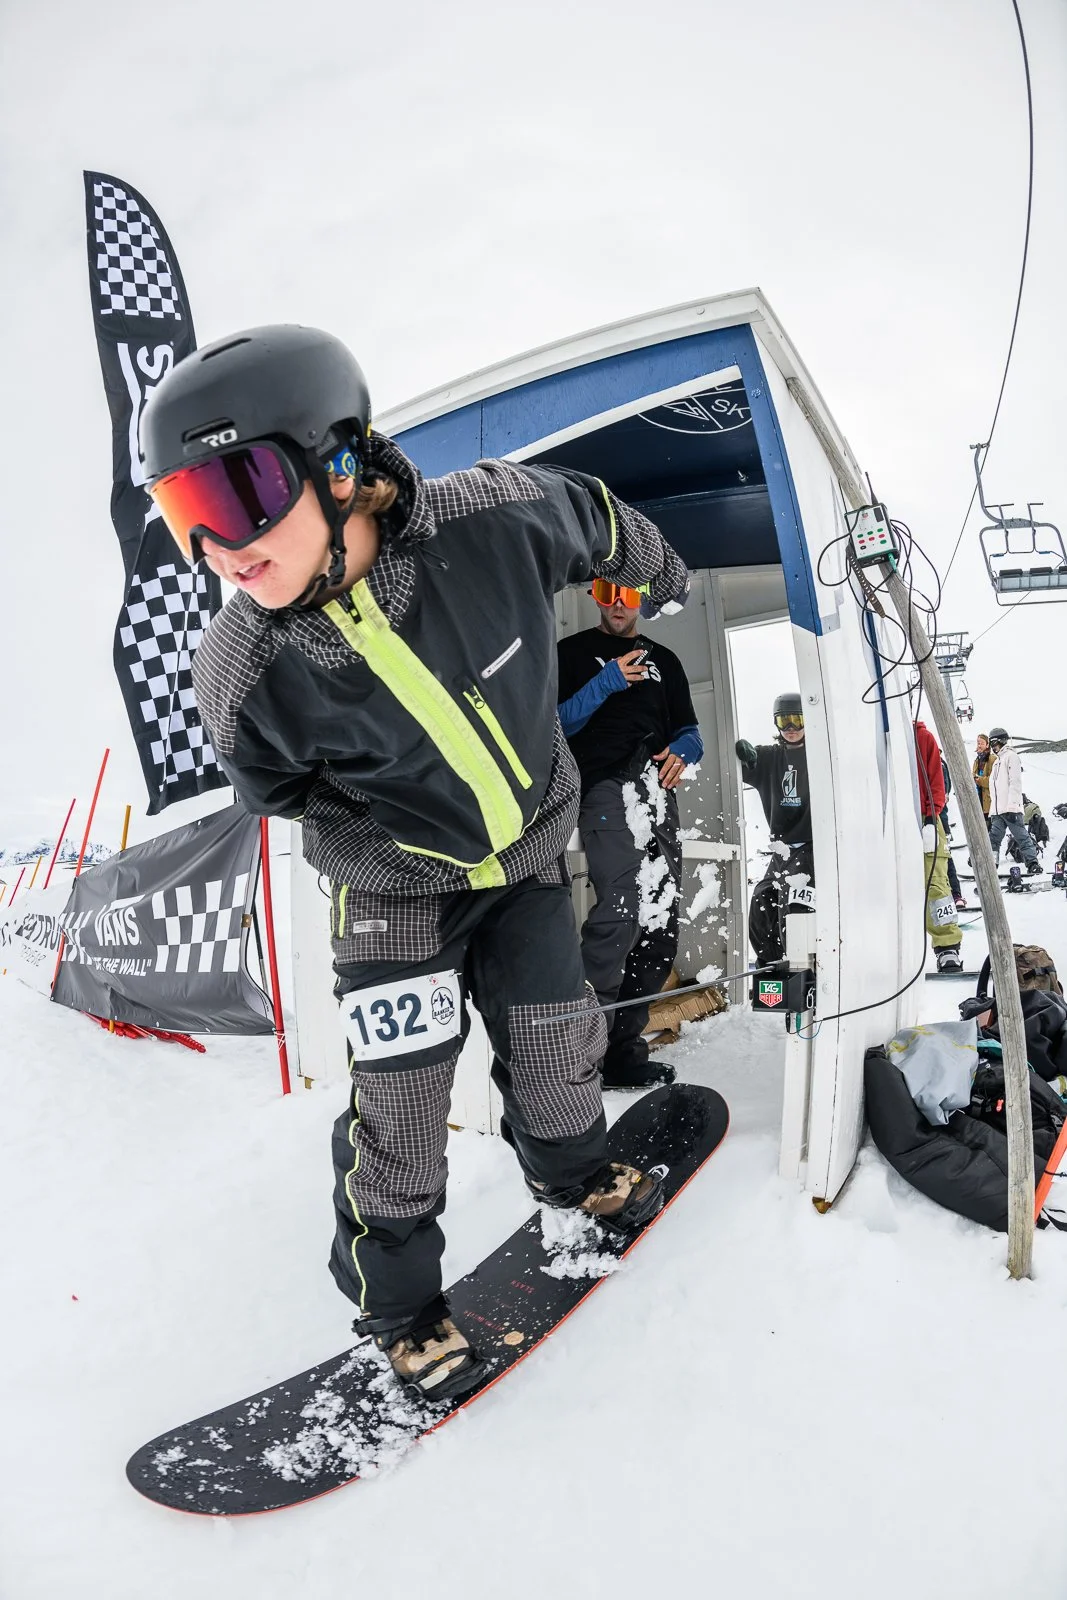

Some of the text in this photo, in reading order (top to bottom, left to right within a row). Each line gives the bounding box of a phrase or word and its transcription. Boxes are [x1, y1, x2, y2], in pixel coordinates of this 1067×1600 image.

[792, 888, 813, 903] 145
[936, 904, 954, 919] 243
[94, 894, 142, 946] VANS
[762, 983, 780, 993] TAG
[349, 992, 429, 1046] 132
